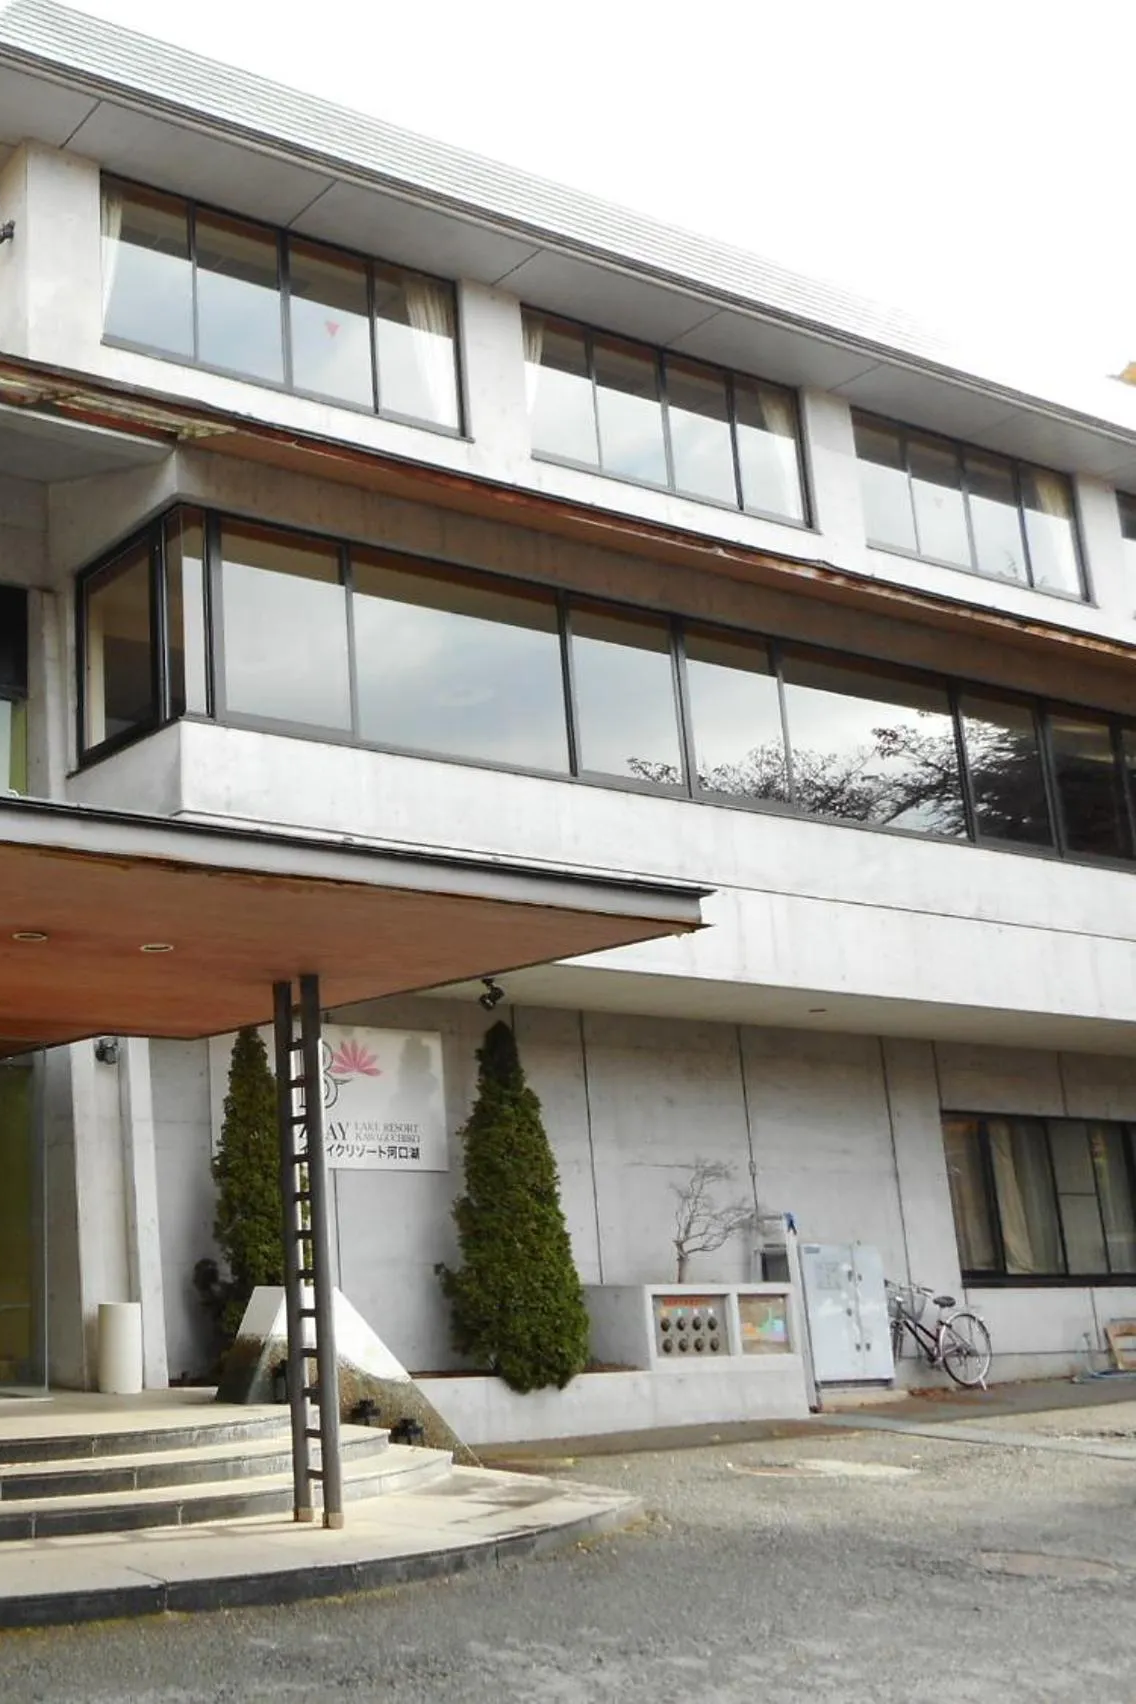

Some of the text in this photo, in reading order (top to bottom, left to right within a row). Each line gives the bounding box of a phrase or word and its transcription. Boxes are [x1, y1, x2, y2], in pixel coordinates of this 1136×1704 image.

[383, 1123, 419, 1133] RESORT
[326, 1144, 420, 1160] イクリゾート河口湖
